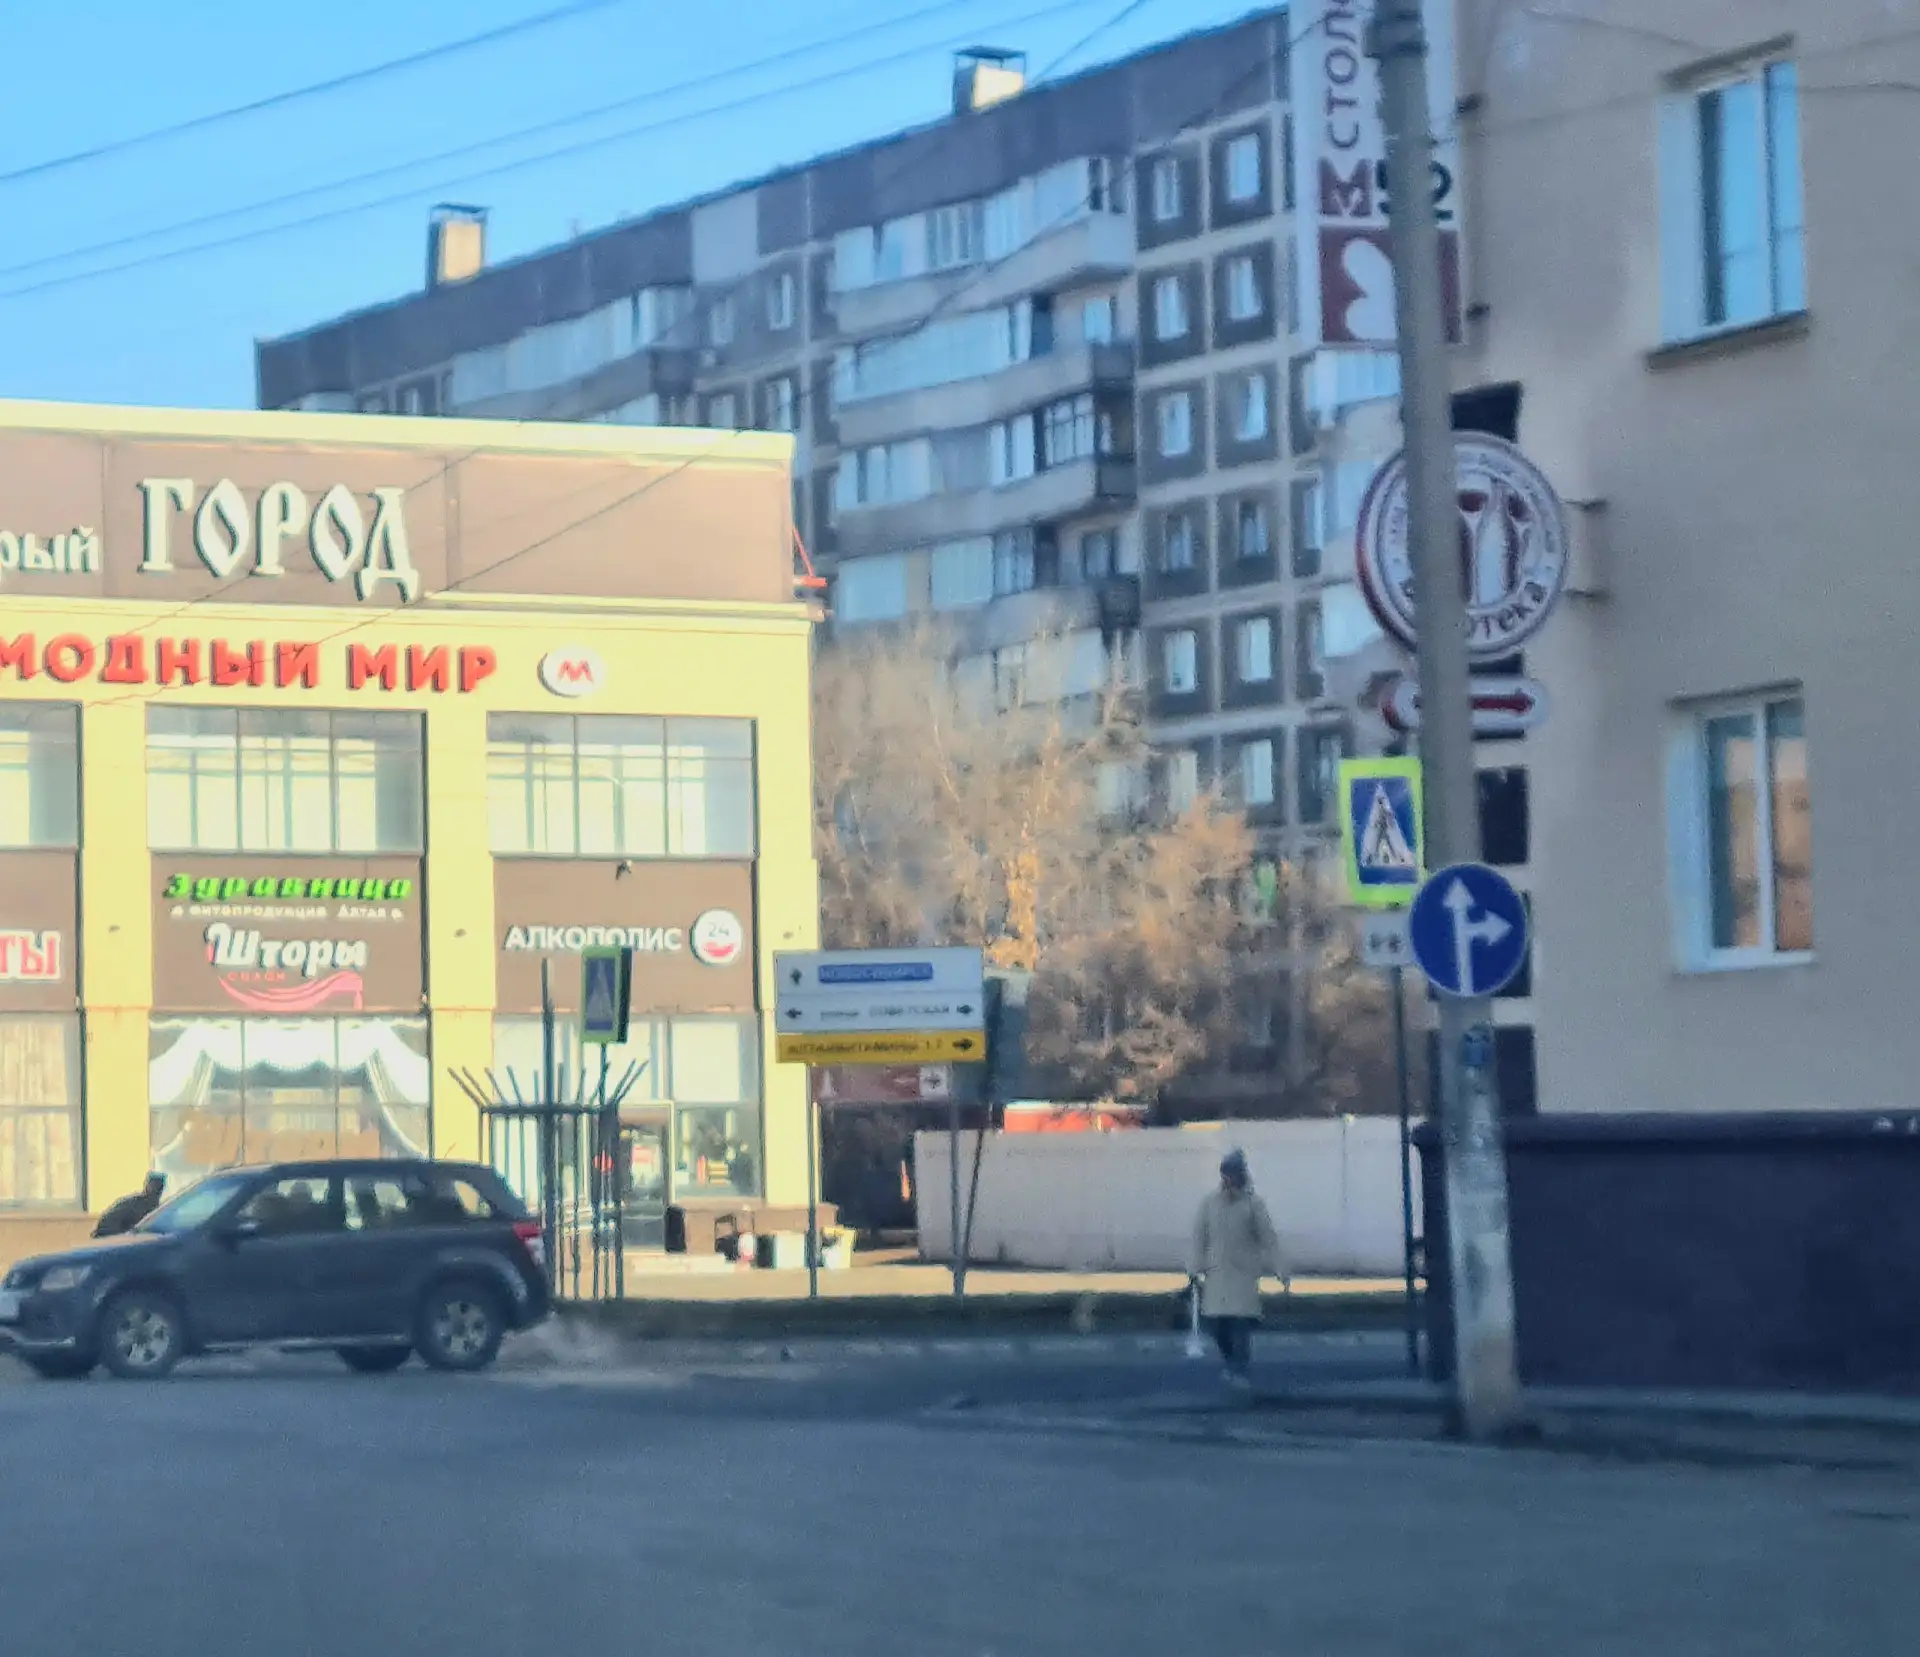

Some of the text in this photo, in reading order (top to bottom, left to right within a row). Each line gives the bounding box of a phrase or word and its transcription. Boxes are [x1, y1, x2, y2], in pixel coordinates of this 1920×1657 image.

[1324, 0, 1359, 149] СТОЛ
[137, 477, 419, 602] ГОРОД
[345, 643, 497, 693] МИР
[203, 922, 367, 978] Шторы
[504, 925, 682, 951] АЛКОПОЛИС
[708, 922, 730, 937] 24
